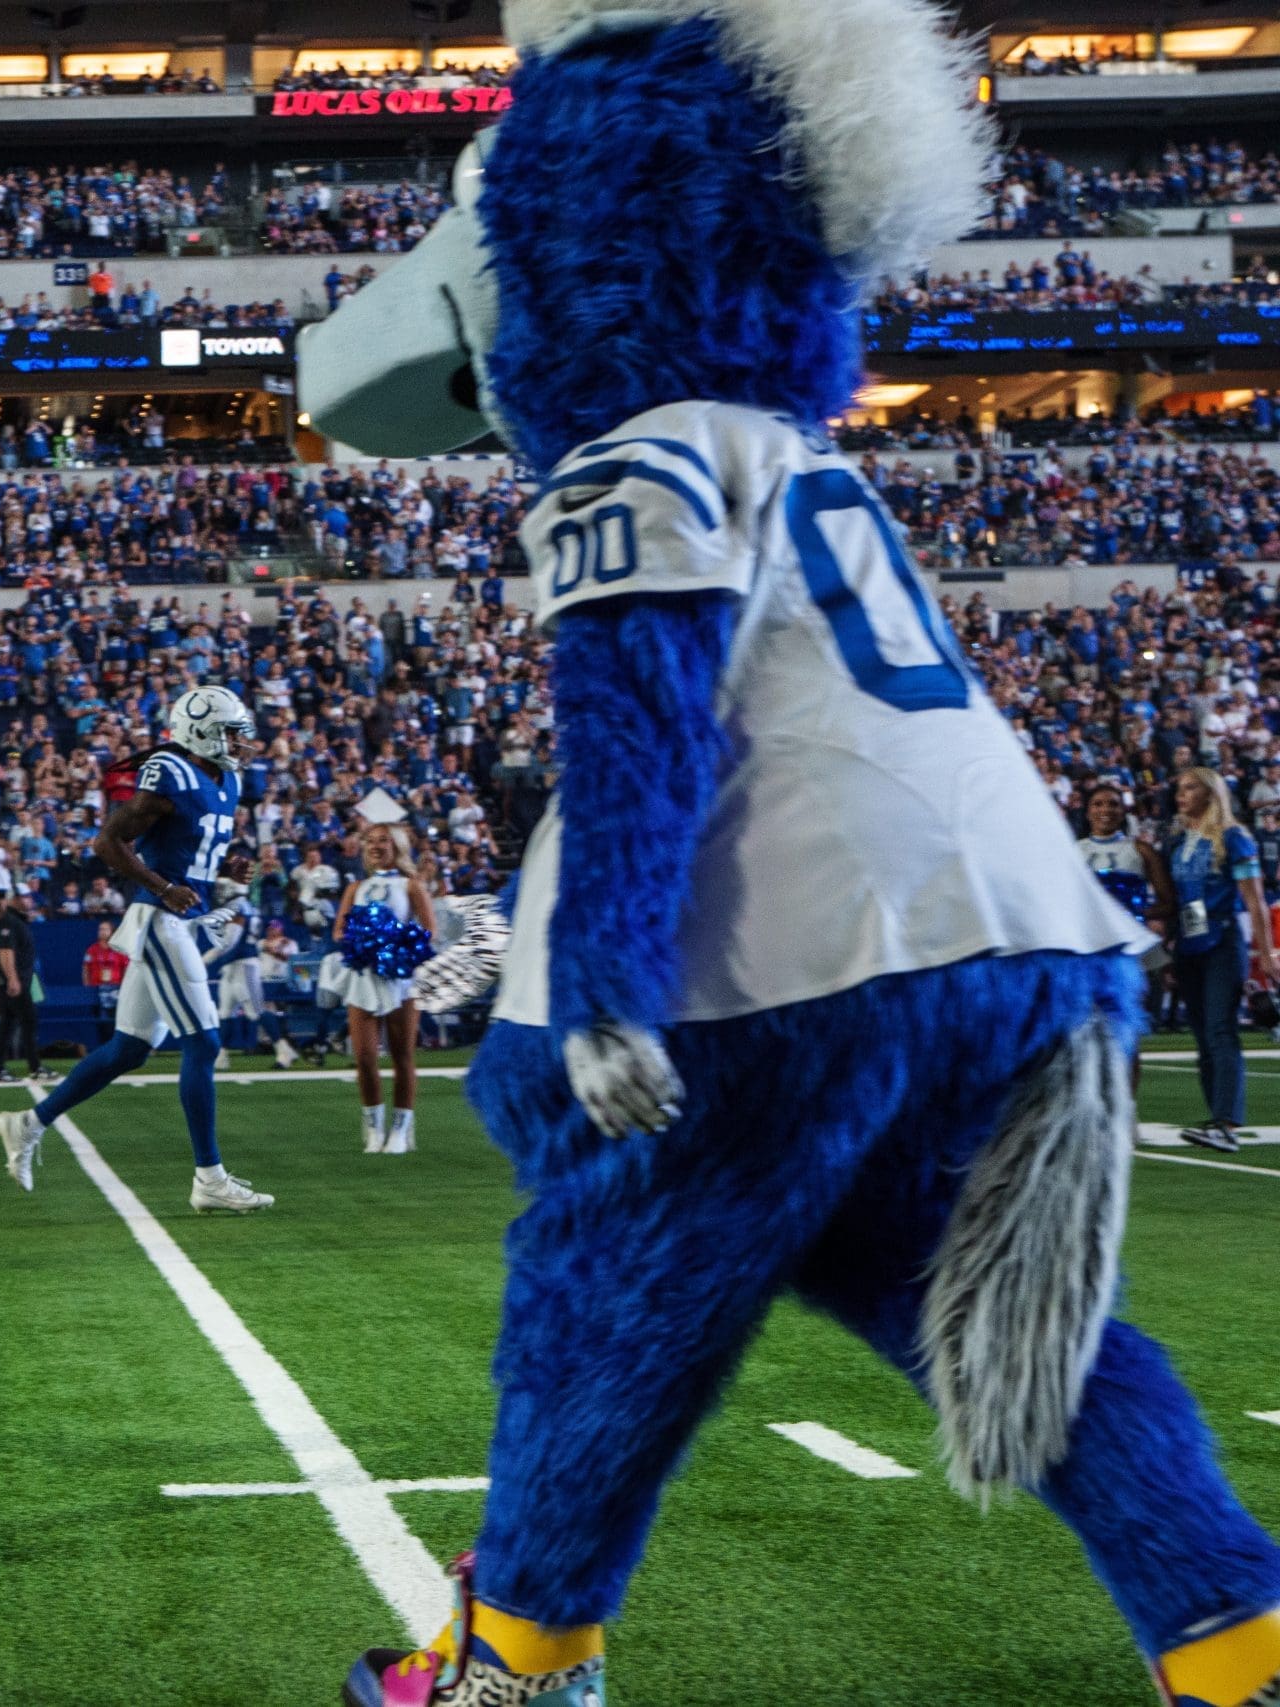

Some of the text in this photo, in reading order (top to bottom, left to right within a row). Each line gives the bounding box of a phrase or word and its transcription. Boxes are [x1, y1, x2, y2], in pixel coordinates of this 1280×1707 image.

[271, 90, 381, 116] LUCAS
[385, 88, 446, 114] OIL
[202, 337, 284, 355] TOYOTA
[551, 503, 636, 598] 00
[139, 768, 162, 792] 12
[186, 812, 234, 883] 12
